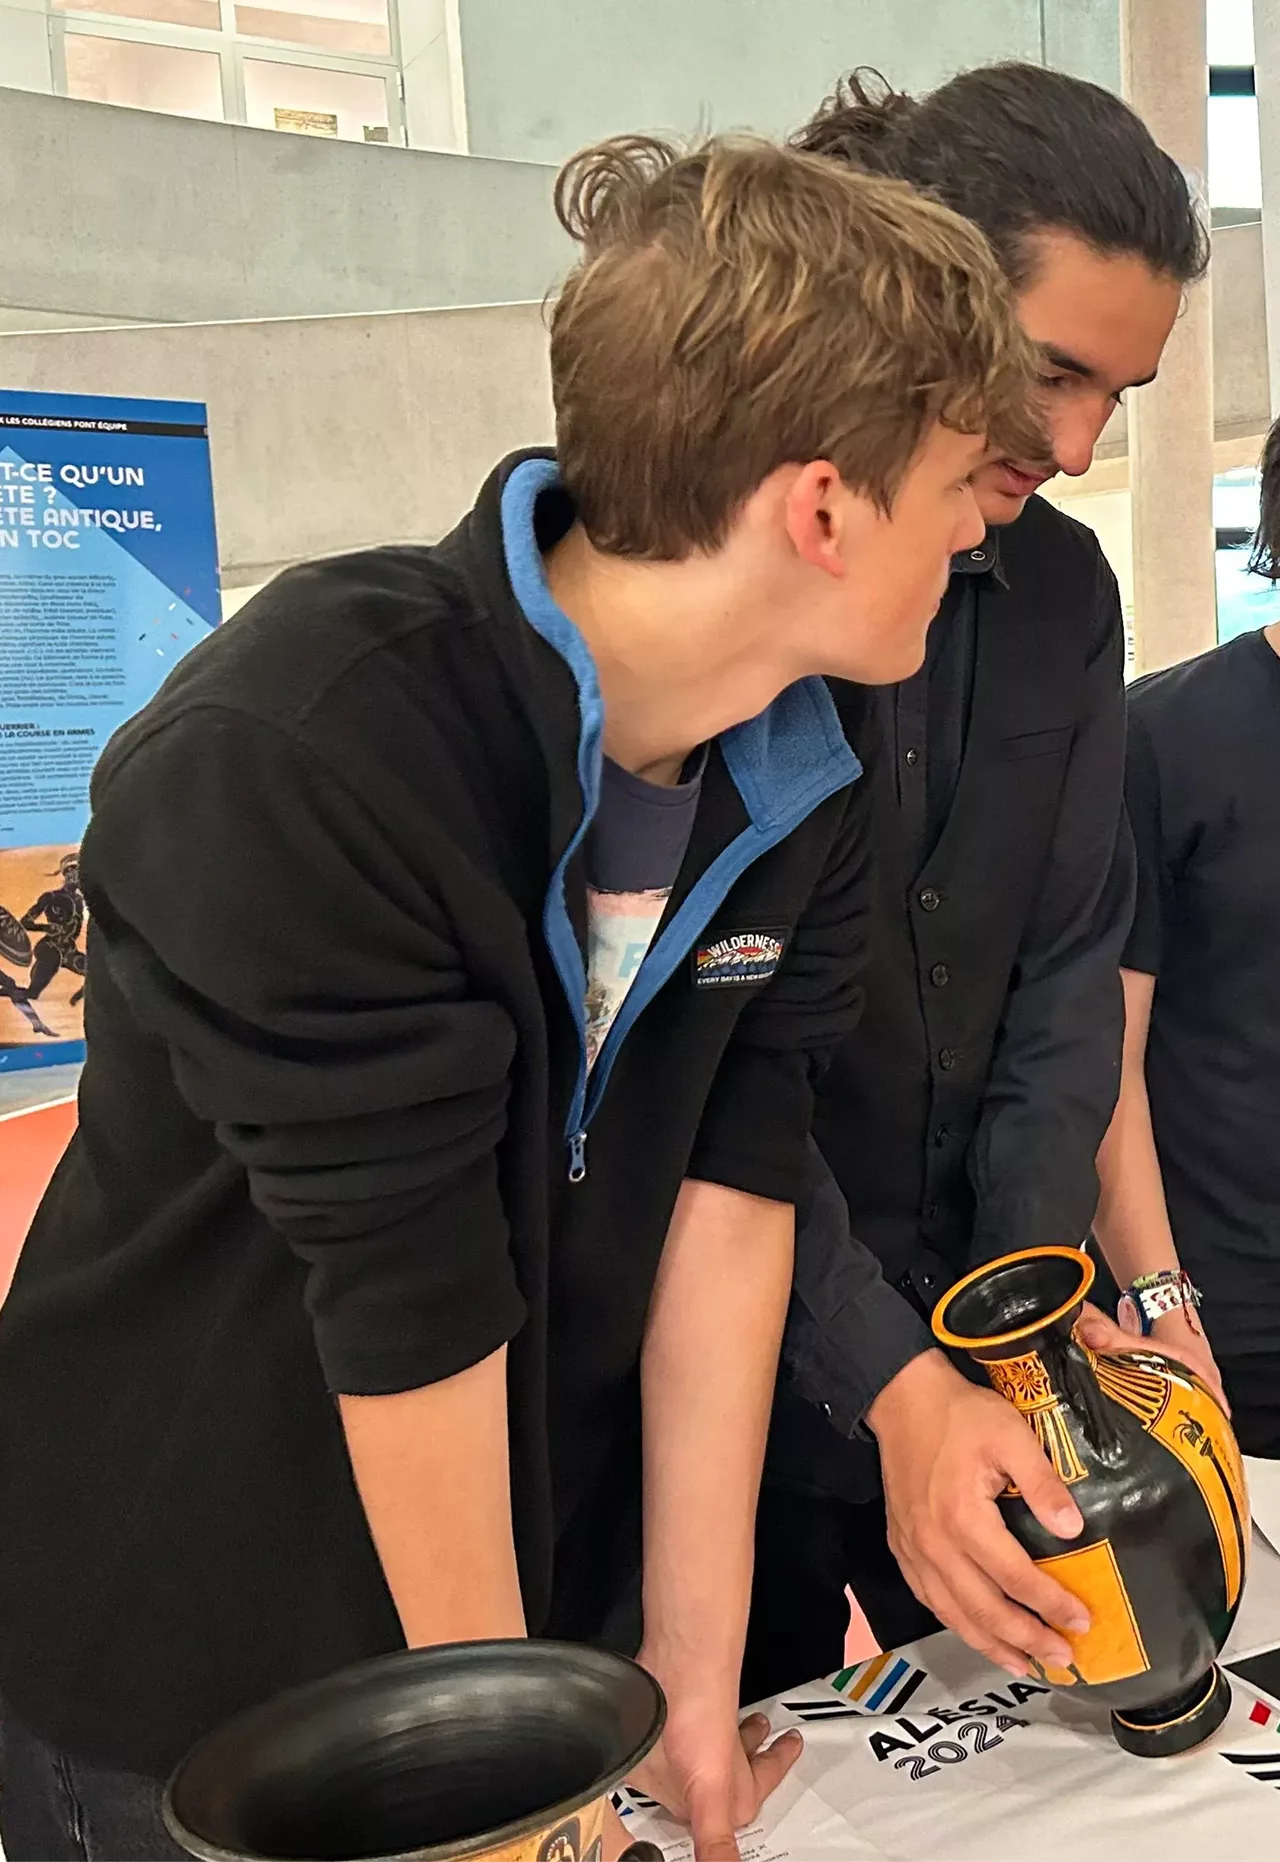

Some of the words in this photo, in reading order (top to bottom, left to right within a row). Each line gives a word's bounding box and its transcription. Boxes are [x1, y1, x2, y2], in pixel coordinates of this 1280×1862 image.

[6, 416, 21, 425] LES
[73, 420, 97, 430] FONT
[60, 464, 145, 488] QU'UN
[0, 484, 35, 504] TE
[43, 485, 57, 505] ?
[0, 506, 35, 526] TE
[43, 508, 162, 533] ANTIQUE,
[26, 529, 81, 549] TOC
[16, 730, 51, 738] COURSE
[52, 729, 65, 737] EN
[697, 976, 720, 985] EVERY
[893, 1714, 1032, 1781] 2024
